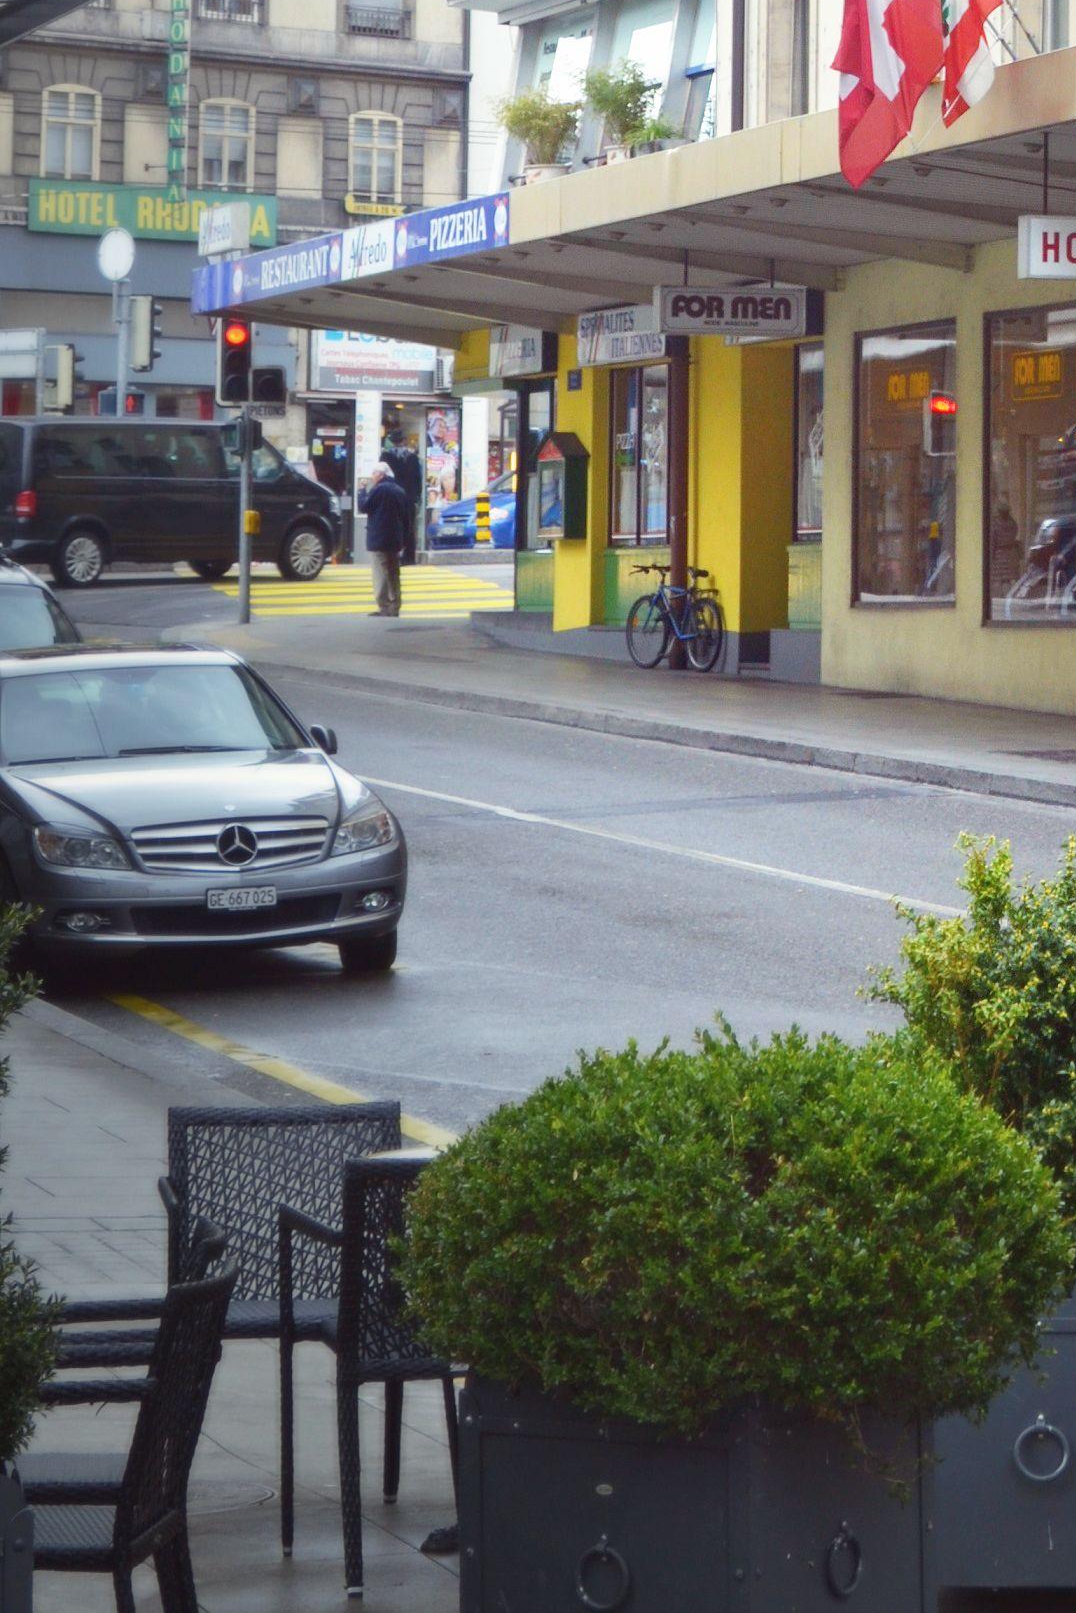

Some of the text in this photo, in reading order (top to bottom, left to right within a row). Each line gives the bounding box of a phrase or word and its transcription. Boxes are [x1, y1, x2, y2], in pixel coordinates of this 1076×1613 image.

[38, 189, 270, 237] HOTEL RHODA
[429, 207, 487, 252] PIZZERIA
[261, 245, 329, 290] RESTAURANT
[671, 294, 791, 320] FOR MEN
[334, 374, 359, 385] Tabac
[209, 893, 225, 907] GE
